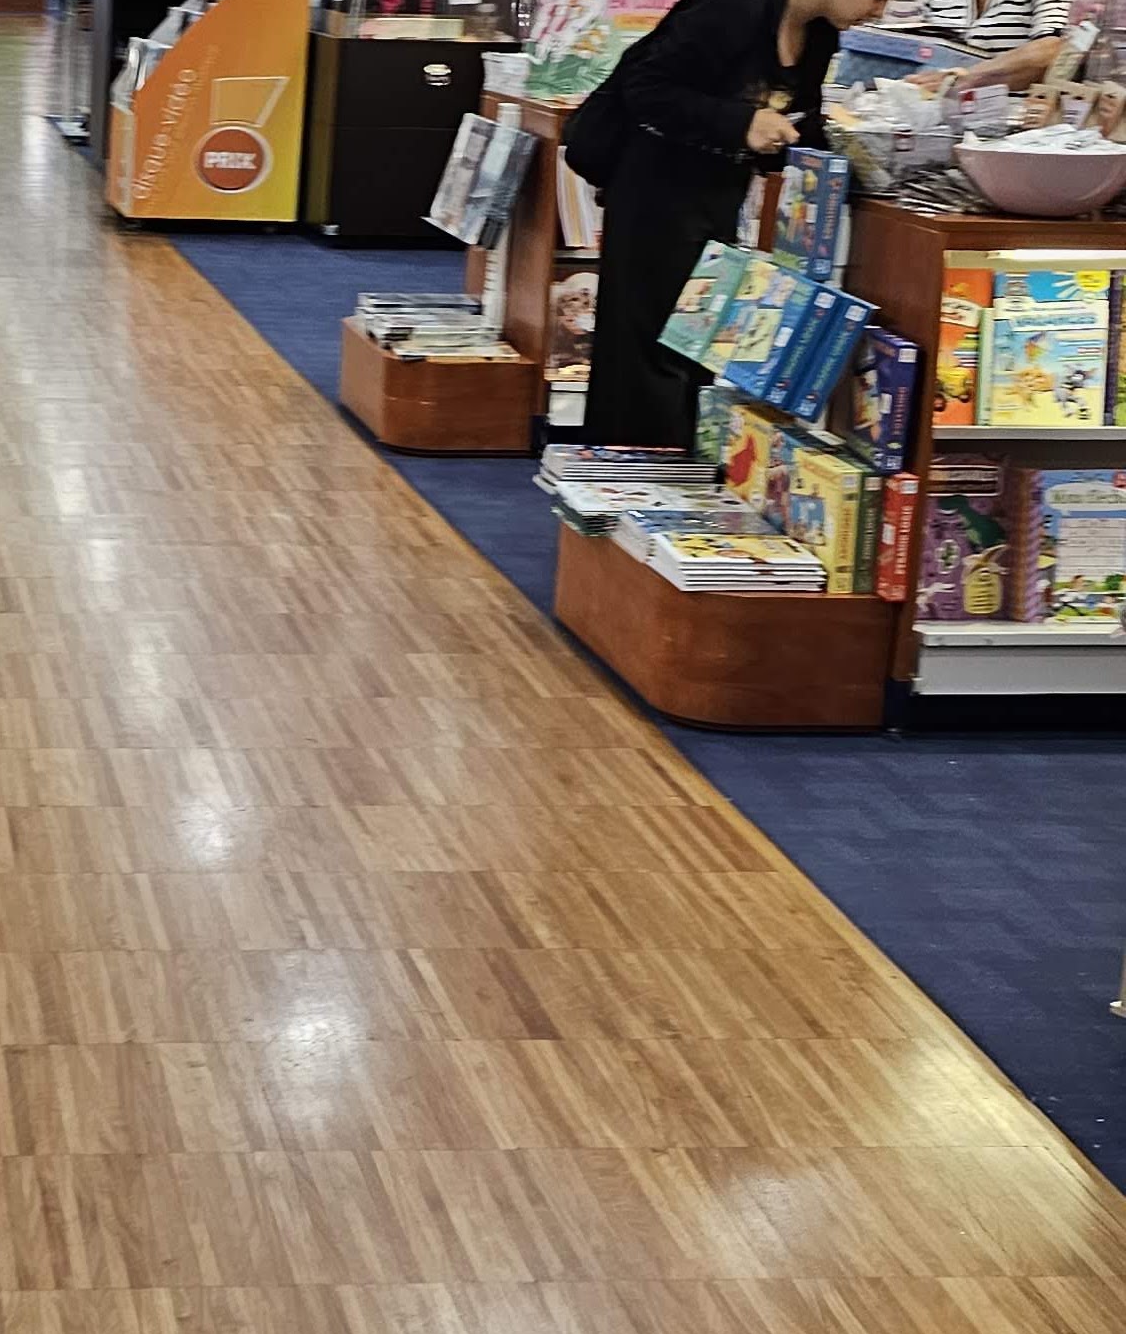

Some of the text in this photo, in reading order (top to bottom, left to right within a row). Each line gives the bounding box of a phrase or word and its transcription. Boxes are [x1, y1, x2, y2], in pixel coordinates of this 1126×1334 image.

[132, 133, 171, 199] disque
[203, 151, 258, 170] PRIX
[899, 505, 914, 533] LOGIC
